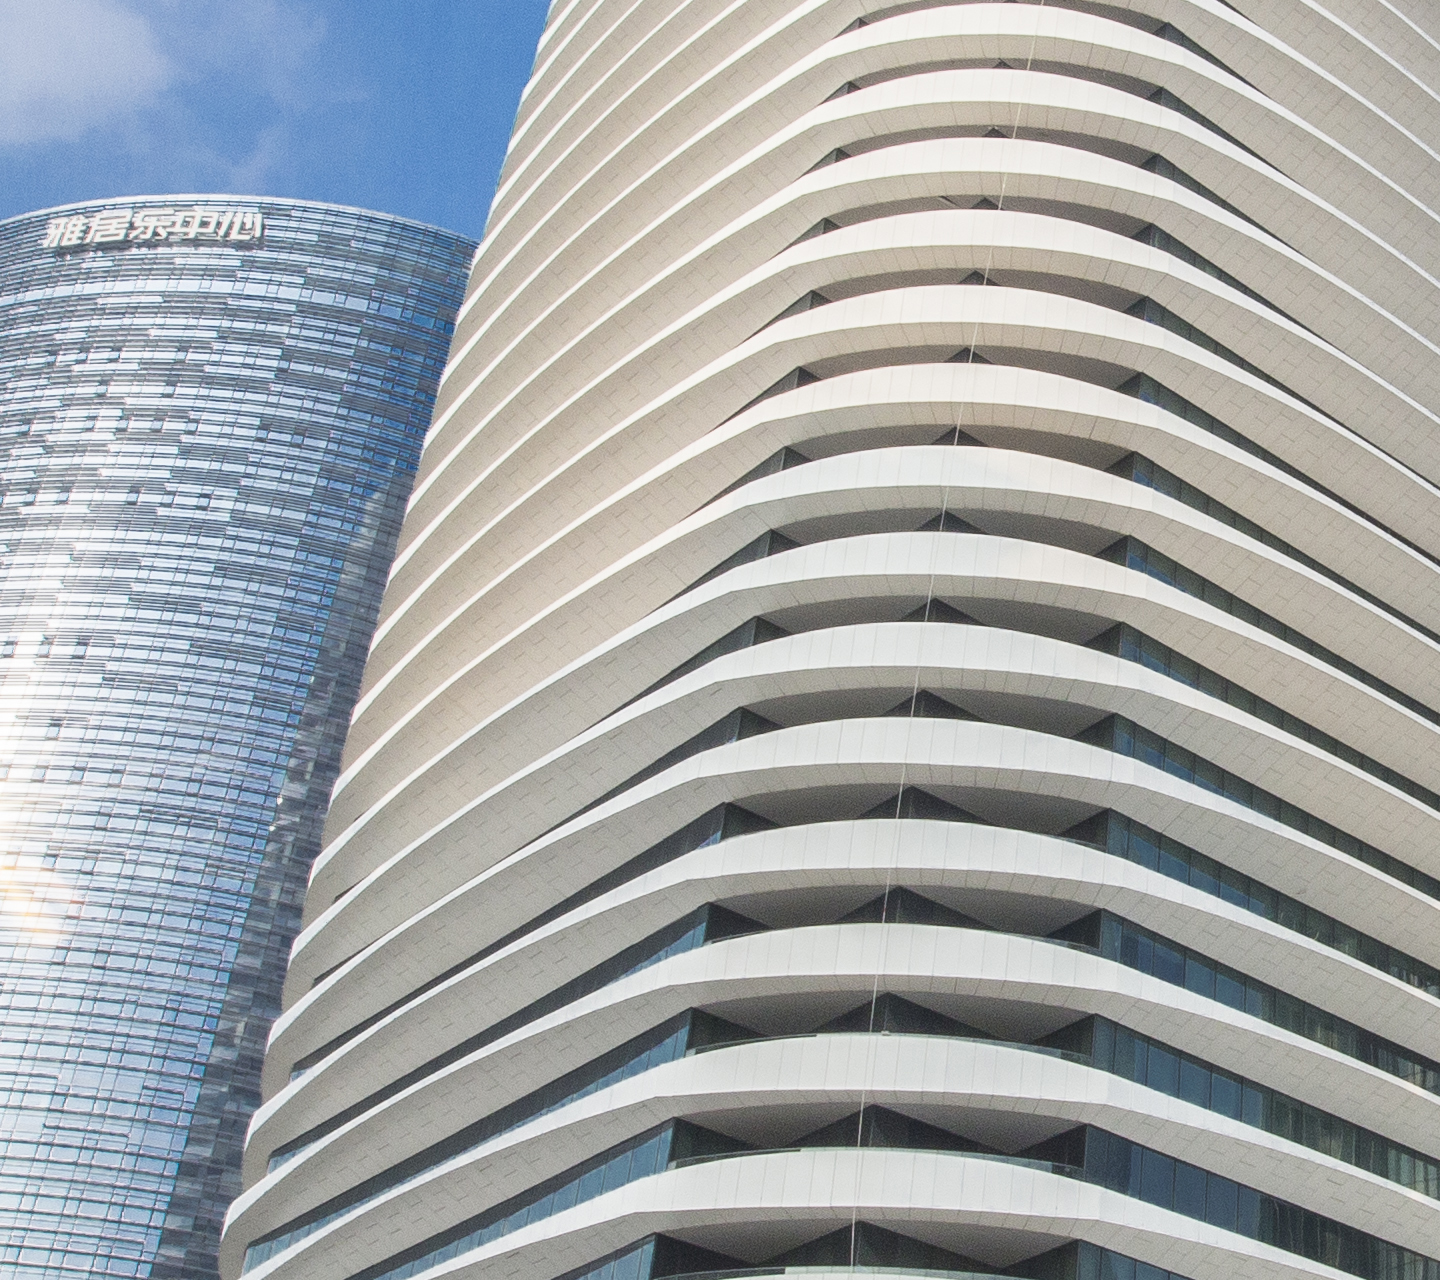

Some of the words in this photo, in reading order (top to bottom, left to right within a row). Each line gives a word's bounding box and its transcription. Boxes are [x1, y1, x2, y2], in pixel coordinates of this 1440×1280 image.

[40, 207, 265, 248] 雅居乐中心
